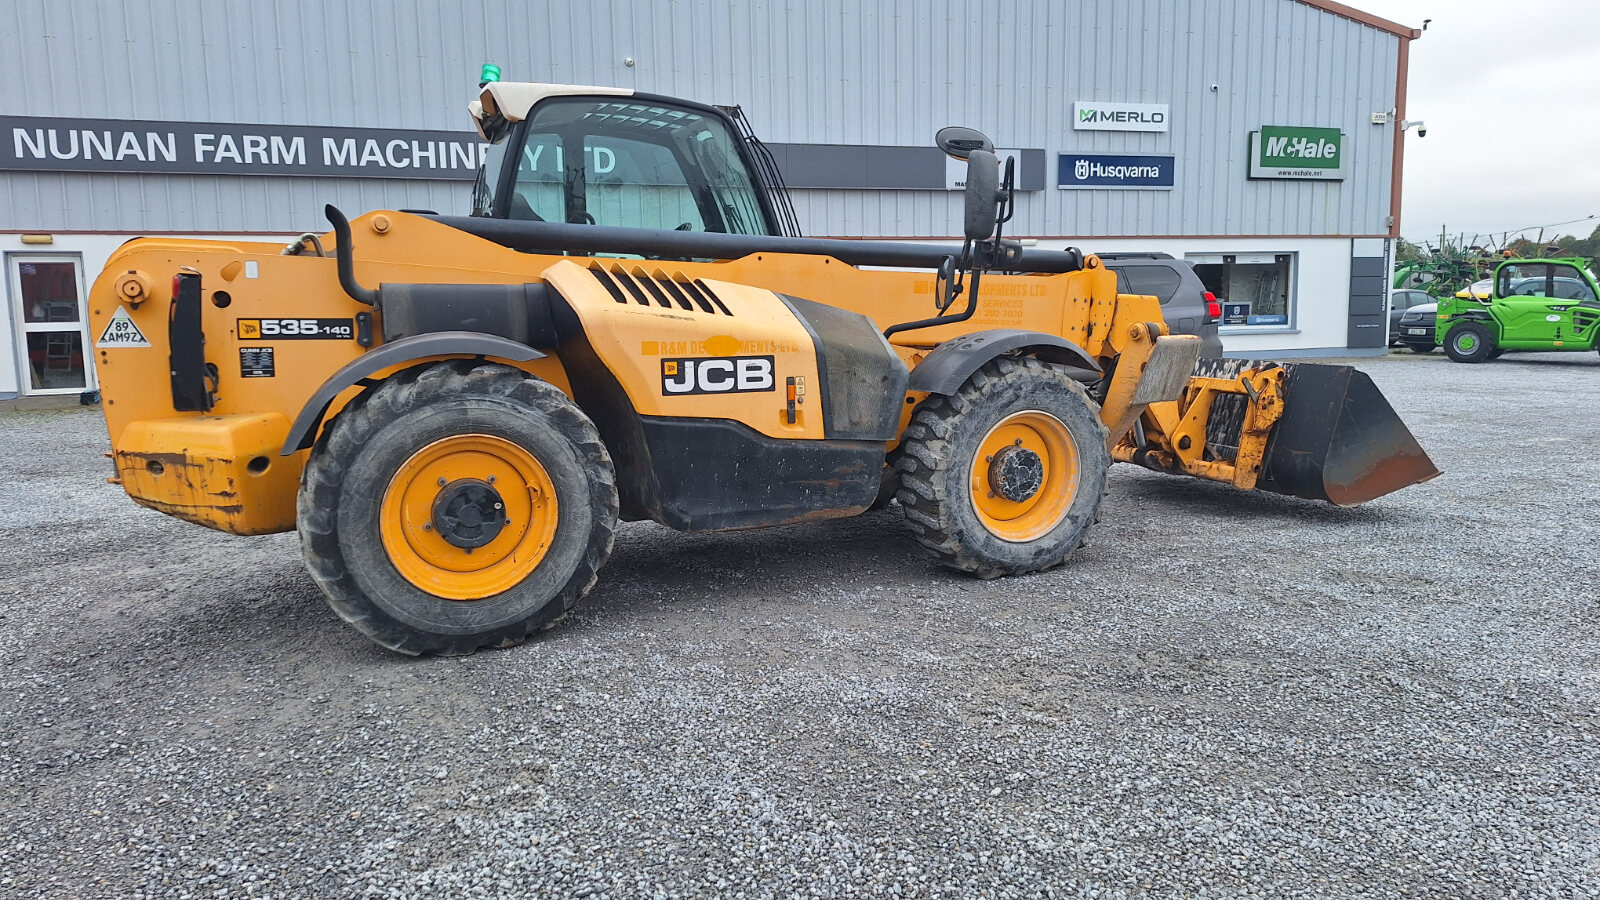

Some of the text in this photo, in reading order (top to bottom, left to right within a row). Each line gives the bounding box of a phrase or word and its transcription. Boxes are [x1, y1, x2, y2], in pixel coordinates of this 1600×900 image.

[1100, 110, 1164, 123] MERLO
[12, 127, 177, 163] NUNAN
[194, 133, 307, 165] FARM
[322, 137, 544, 172] MACHINY
[1265, 136, 1337, 158] McHale
[1090, 162, 1160, 180] Husqvarna
[1277, 169, 1323, 177] www.mchale.net
[1030, 284, 1046, 297] LTD
[982, 299, 1024, 309] SERVICES
[115, 321, 129, 332] 89
[261, 319, 351, 335] 535-140
[108, 332, 138, 343] AM9Z
[660, 341, 687, 356] R&M
[664, 359, 773, 393] JCB
